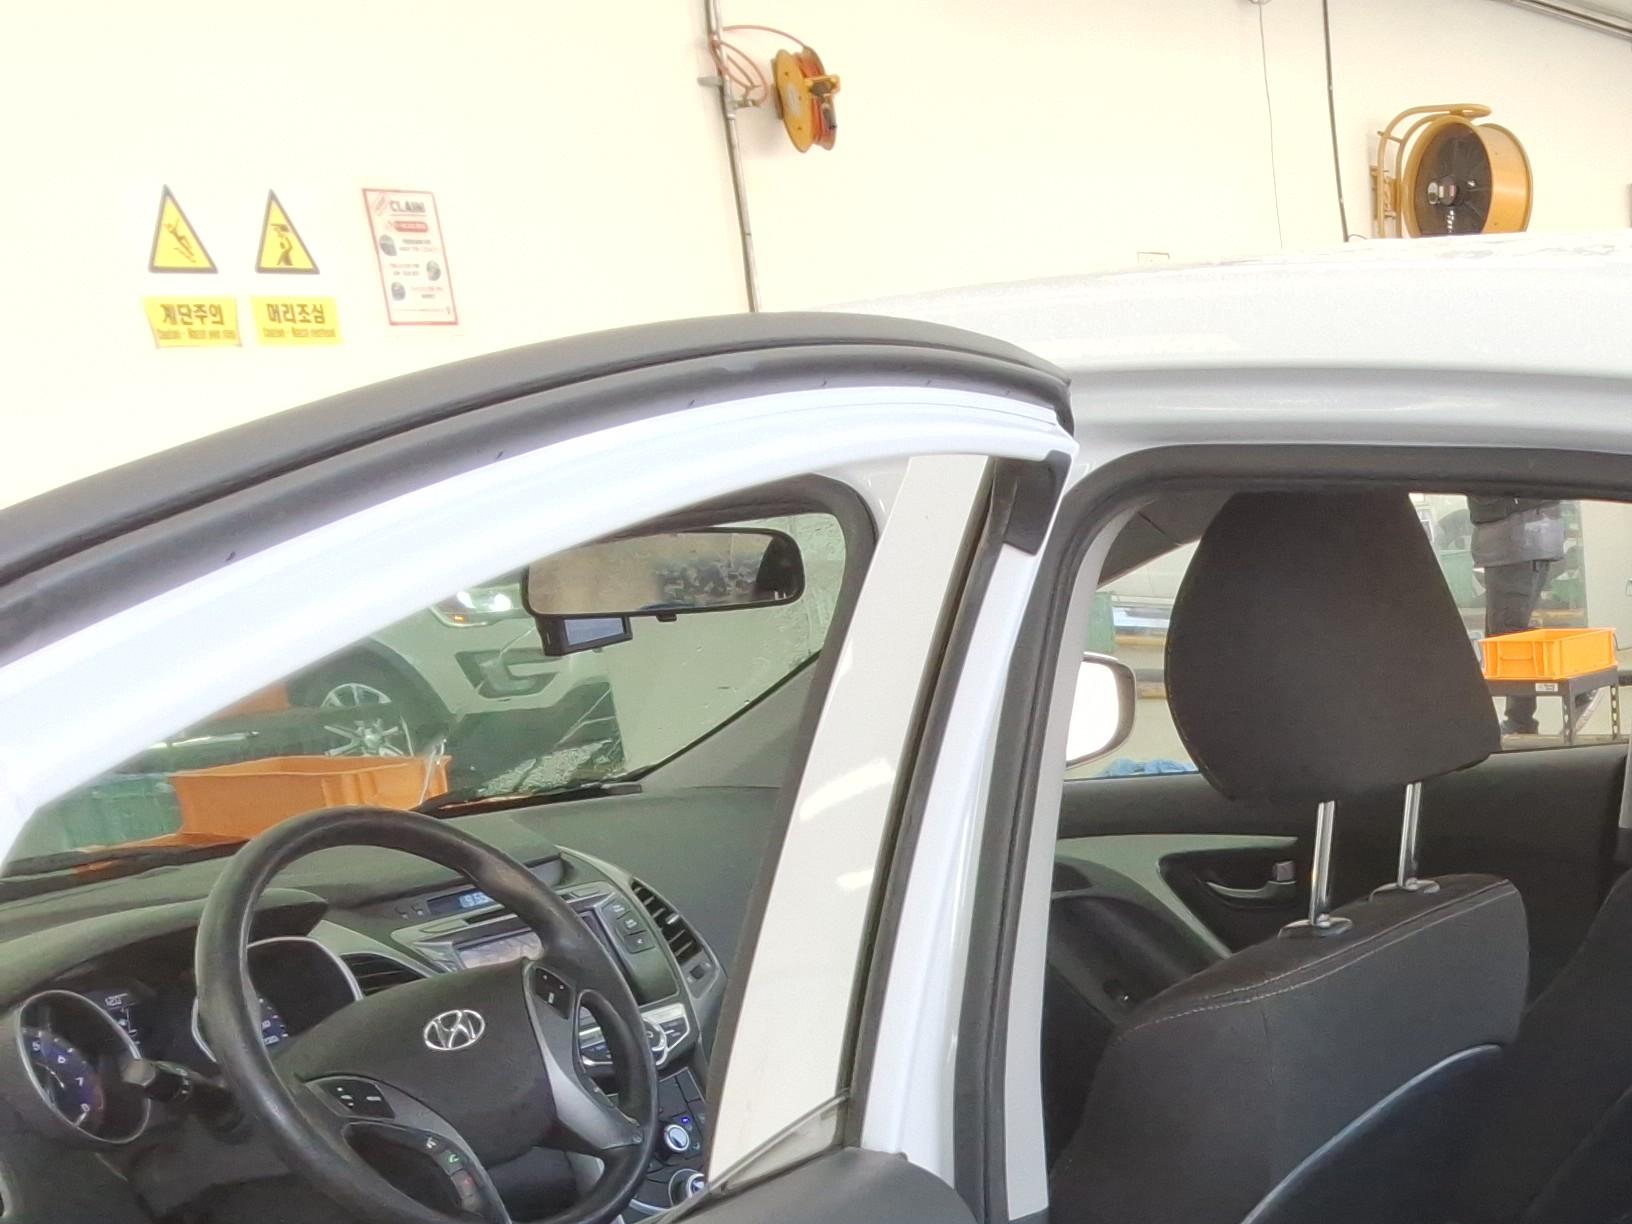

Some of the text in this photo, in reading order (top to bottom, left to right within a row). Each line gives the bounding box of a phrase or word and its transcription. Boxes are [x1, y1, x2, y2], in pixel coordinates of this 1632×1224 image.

[265, 303, 326, 324] 머리조심
[57, 1055, 66, 1064] 6
[75, 1077, 84, 1087] 7
